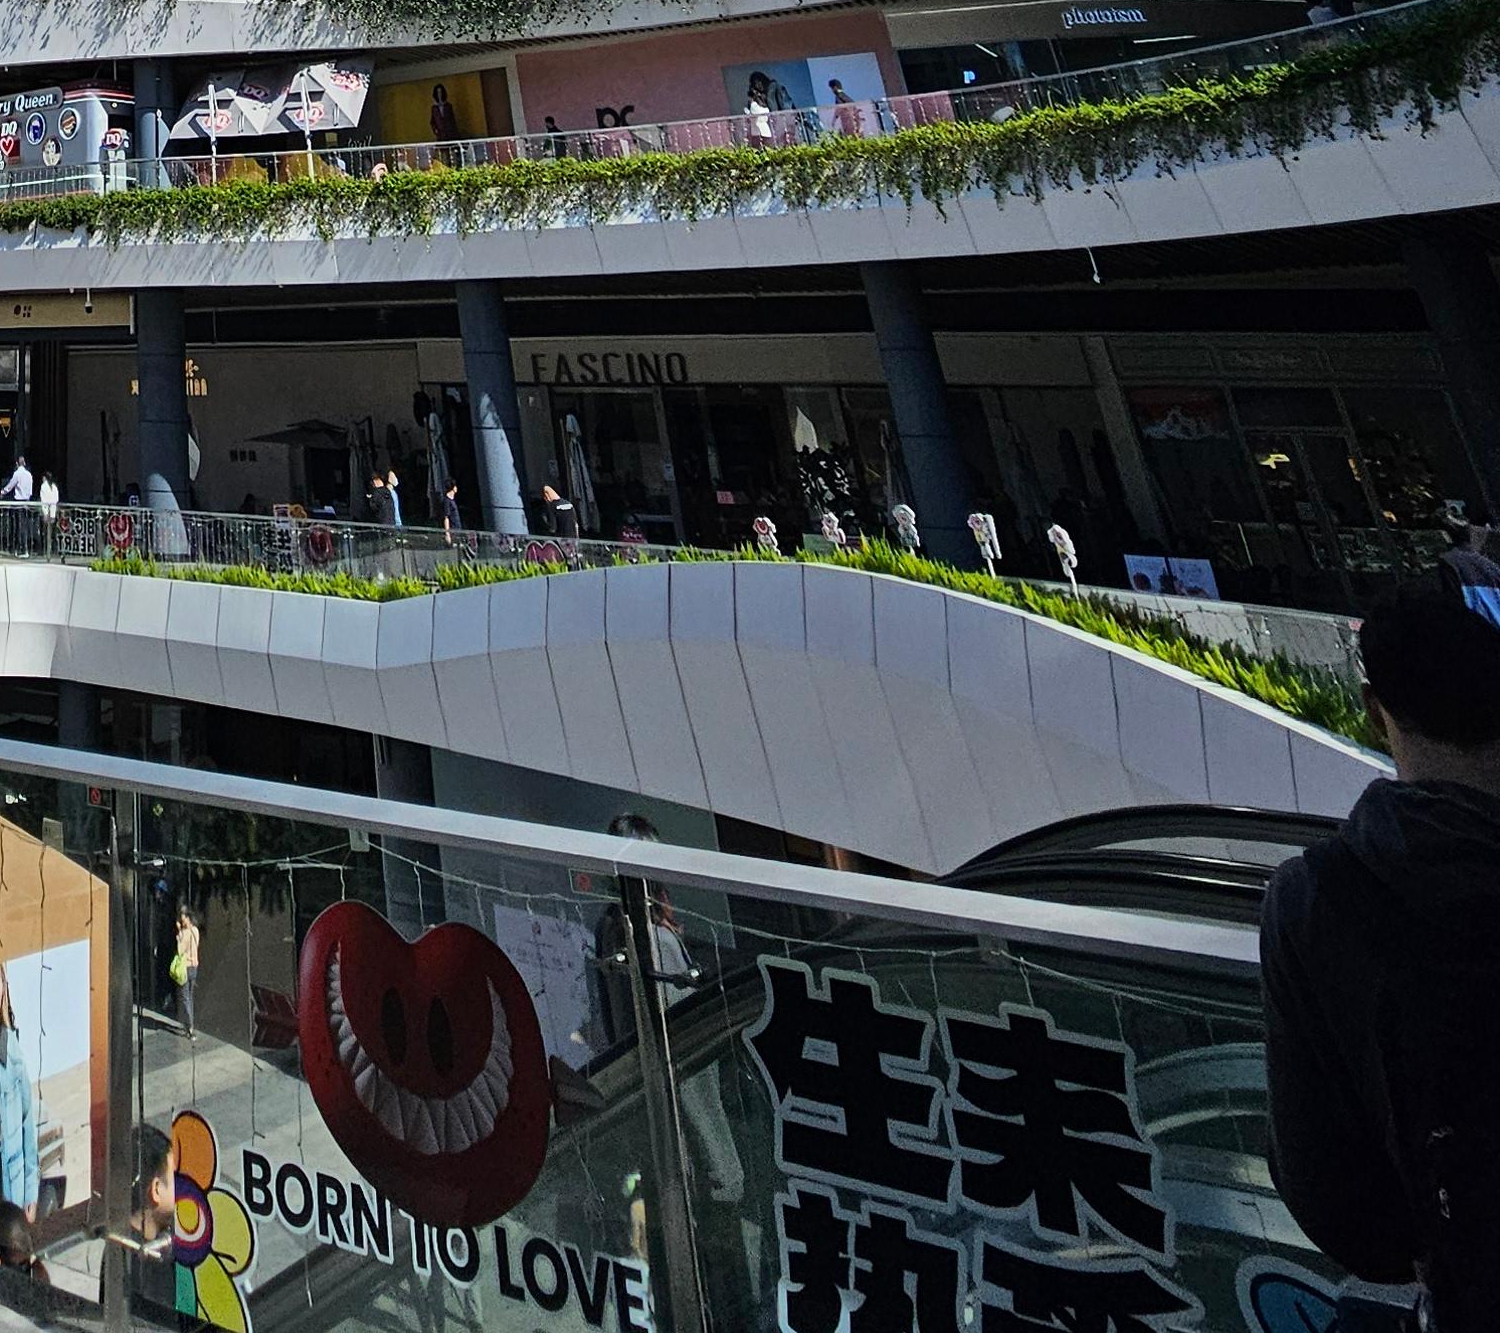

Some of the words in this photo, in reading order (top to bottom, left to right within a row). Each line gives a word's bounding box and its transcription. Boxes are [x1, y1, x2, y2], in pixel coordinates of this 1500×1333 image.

[15, 93, 54, 112] Queen
[0, 120, 18, 136] DQ
[105, 132, 121, 145] DQ
[531, 352, 690, 385] FASCINO
[750, 963, 1168, 1257] 生来
[244, 1149, 392, 1261] BORN
[403, 1211, 481, 1289] TO
[496, 1227, 652, 1333] LOVE
